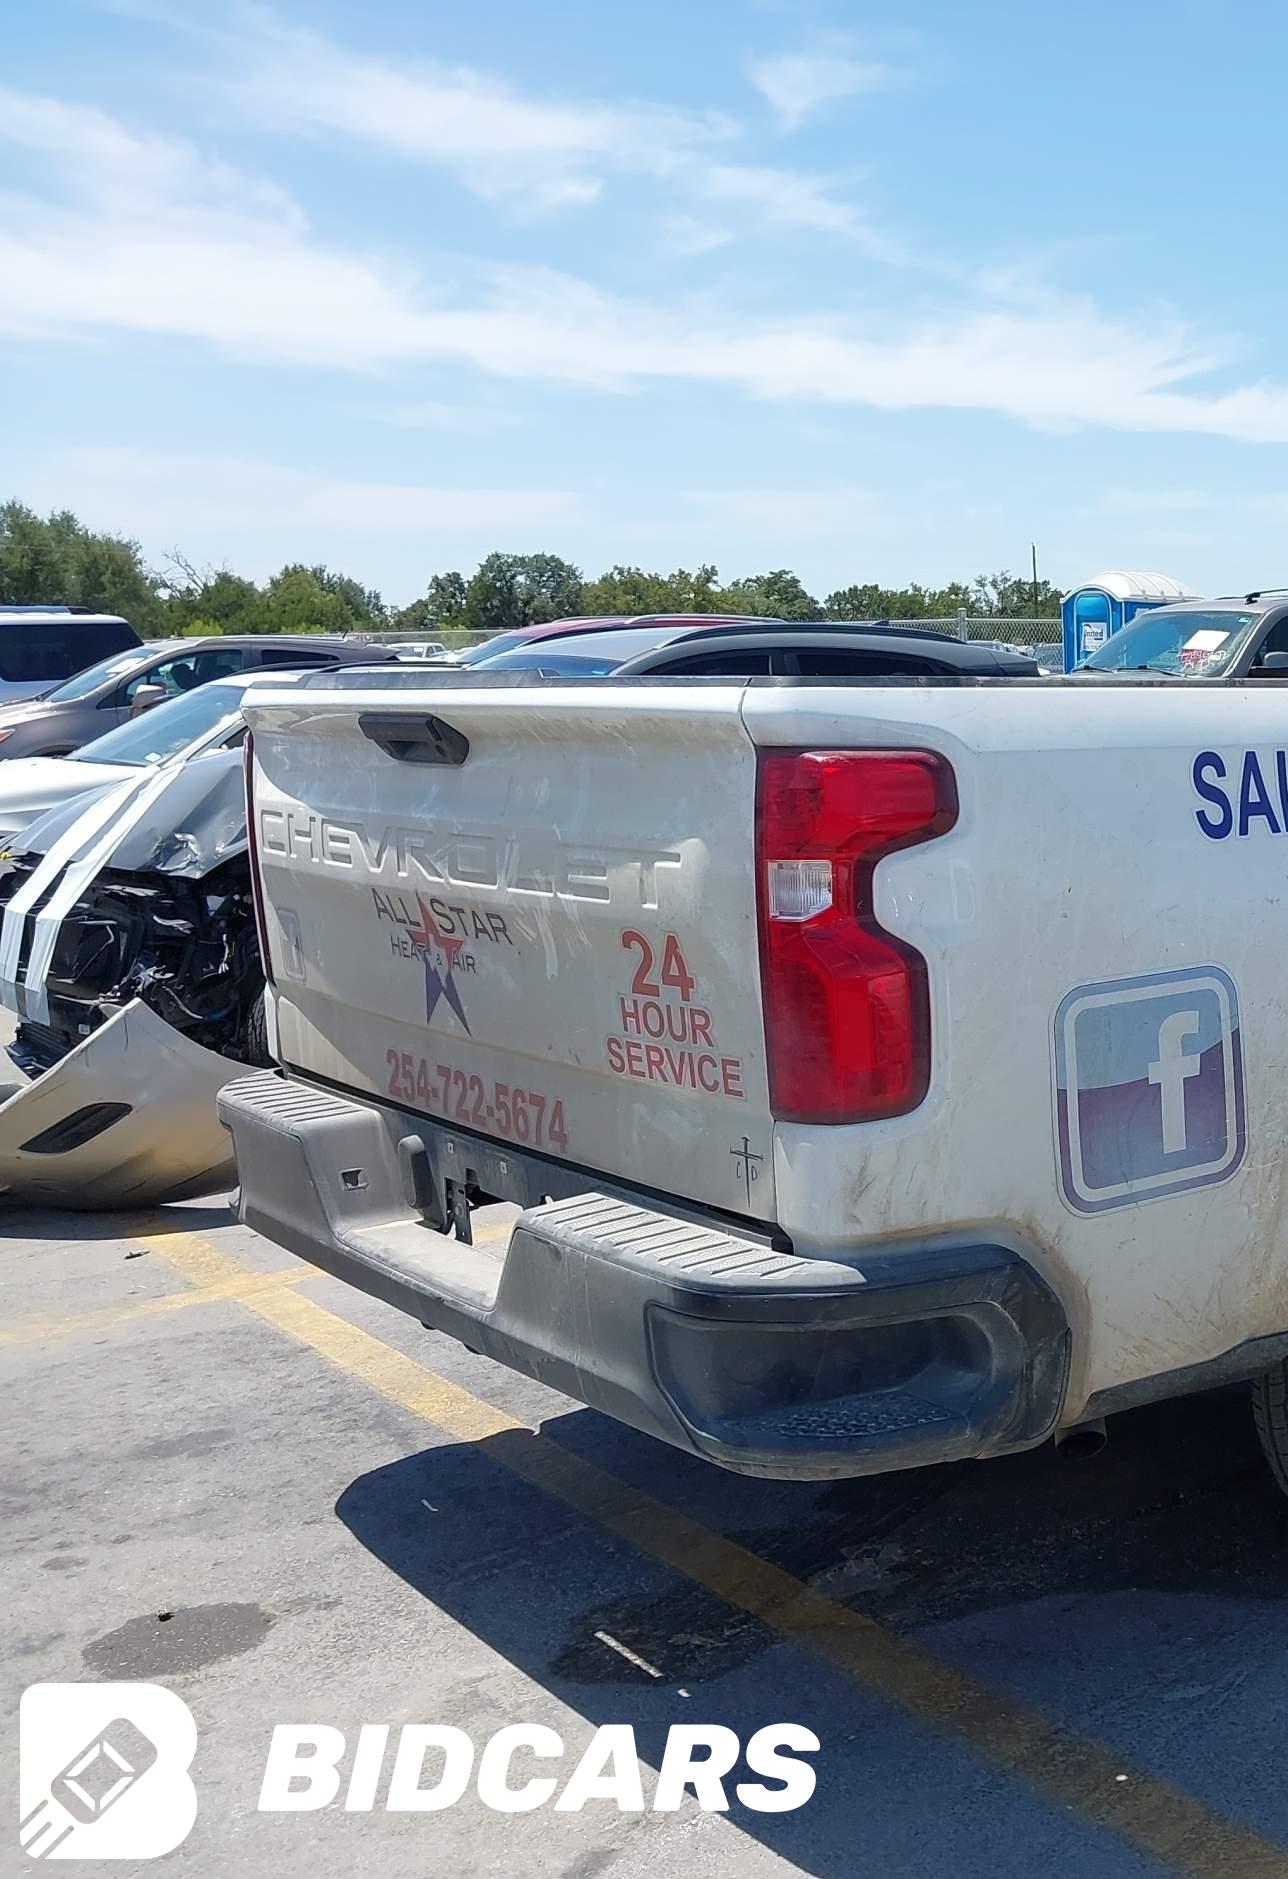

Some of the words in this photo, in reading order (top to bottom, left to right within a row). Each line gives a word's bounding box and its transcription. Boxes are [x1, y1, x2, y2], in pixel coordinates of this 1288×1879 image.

[260, 808, 682, 910] CHEVROLET
[371, 887, 421, 928] ALL
[429, 897, 513, 945] STAR
[390, 935, 426, 962] HEAT
[435, 953, 443, 966] &
[451, 949, 477, 974] AIR
[621, 930, 695, 1002] 24
[619, 996, 714, 1048] HOUR
[606, 1037, 744, 1098] SERVICE
[386, 1048, 569, 1153] 254-722-5674
